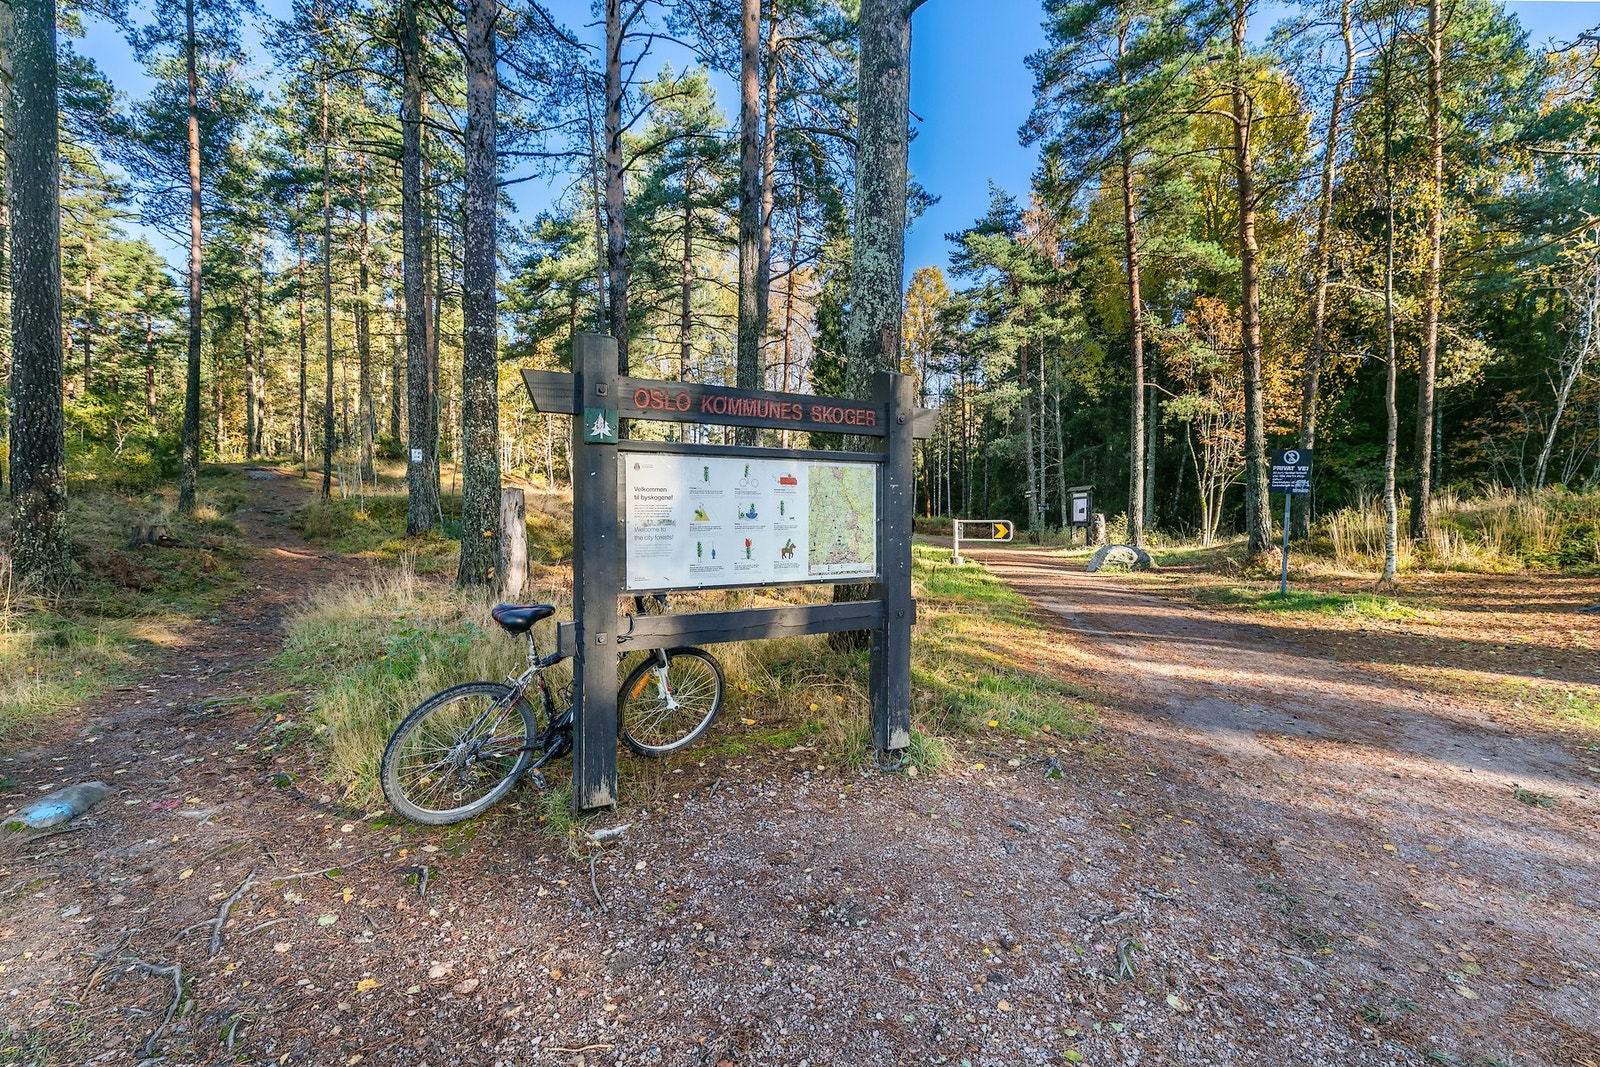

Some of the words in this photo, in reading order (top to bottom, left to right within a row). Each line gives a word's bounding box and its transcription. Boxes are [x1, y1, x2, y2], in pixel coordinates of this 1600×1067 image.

[633, 388, 692, 412] OSLO
[701, 396, 803, 421] KOMMUNES
[811, 405, 876, 427] SKOGER
[641, 494, 674, 502] byskogene!
